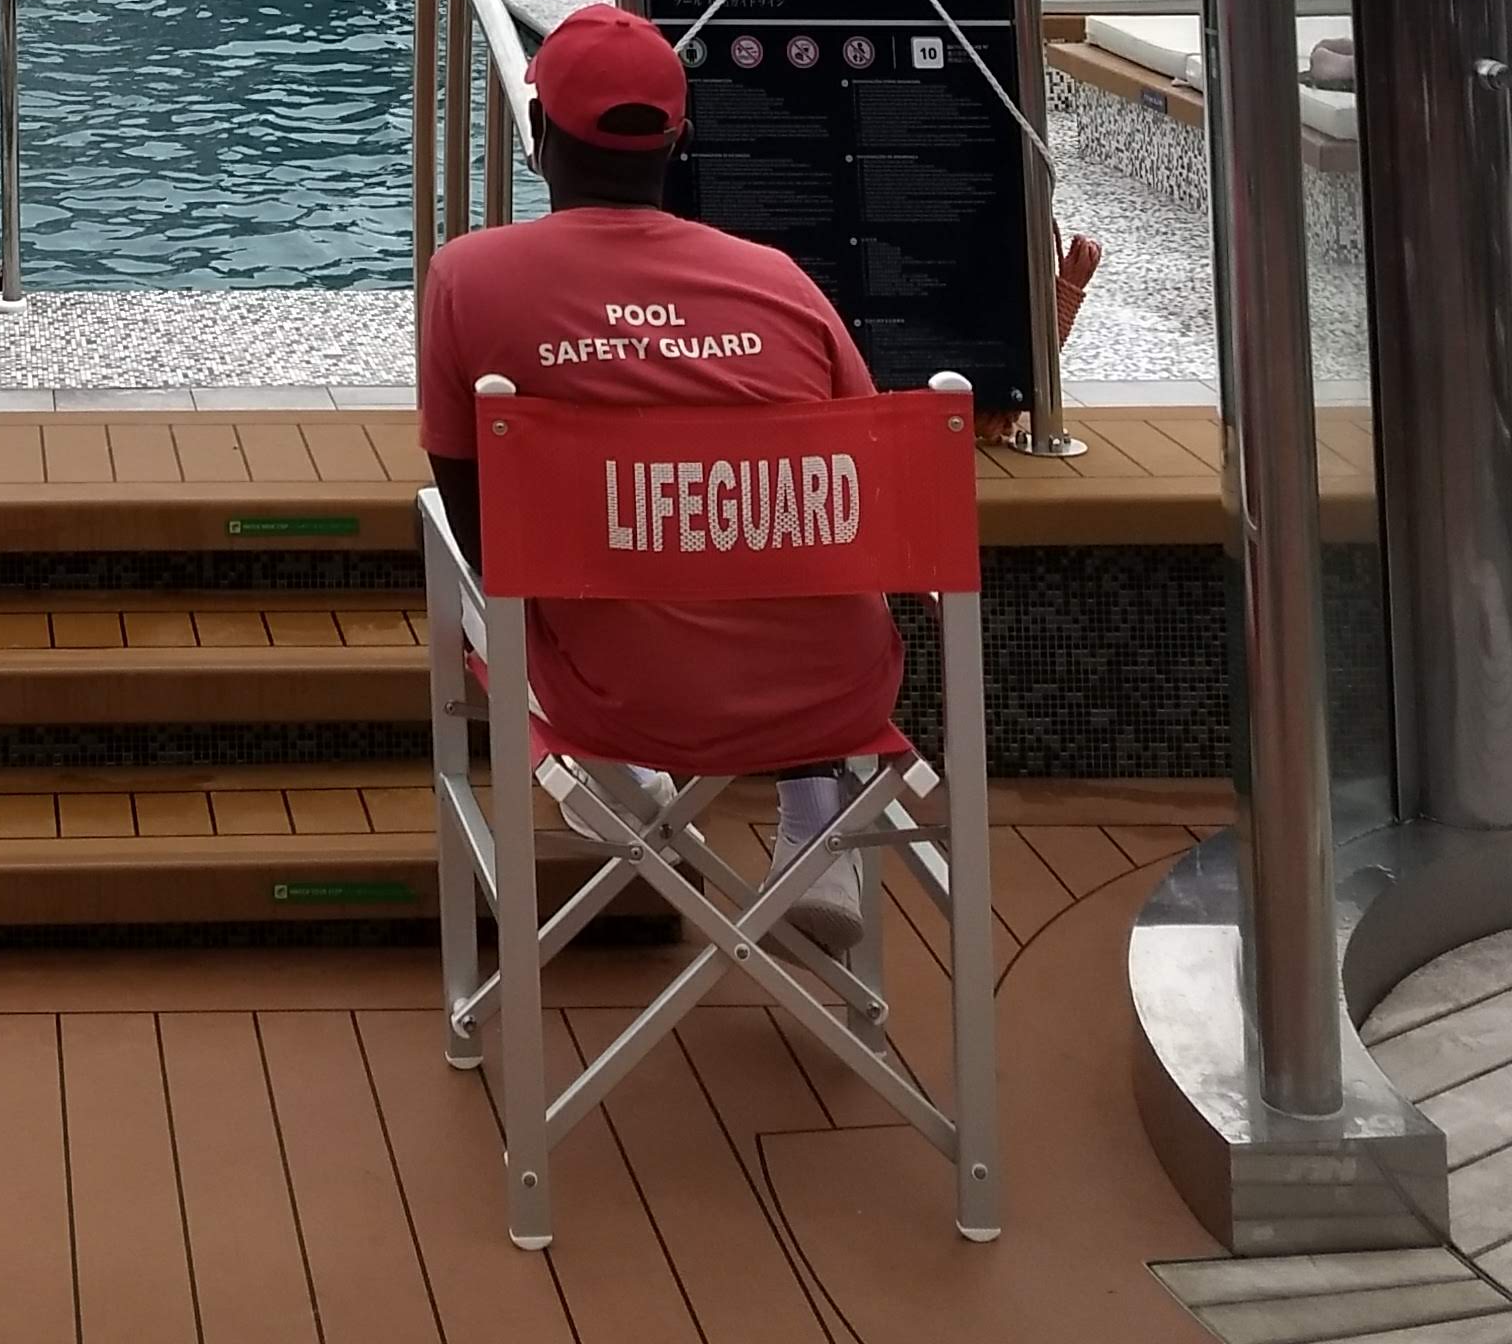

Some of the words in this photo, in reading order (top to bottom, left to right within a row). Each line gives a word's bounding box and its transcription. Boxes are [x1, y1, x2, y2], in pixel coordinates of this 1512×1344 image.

[919, 47, 937, 60] 10
[605, 303, 686, 326] POOL
[538, 337, 650, 366] SAFETY
[658, 332, 763, 359] GUARD
[605, 453, 860, 553] LIFEGUARD
